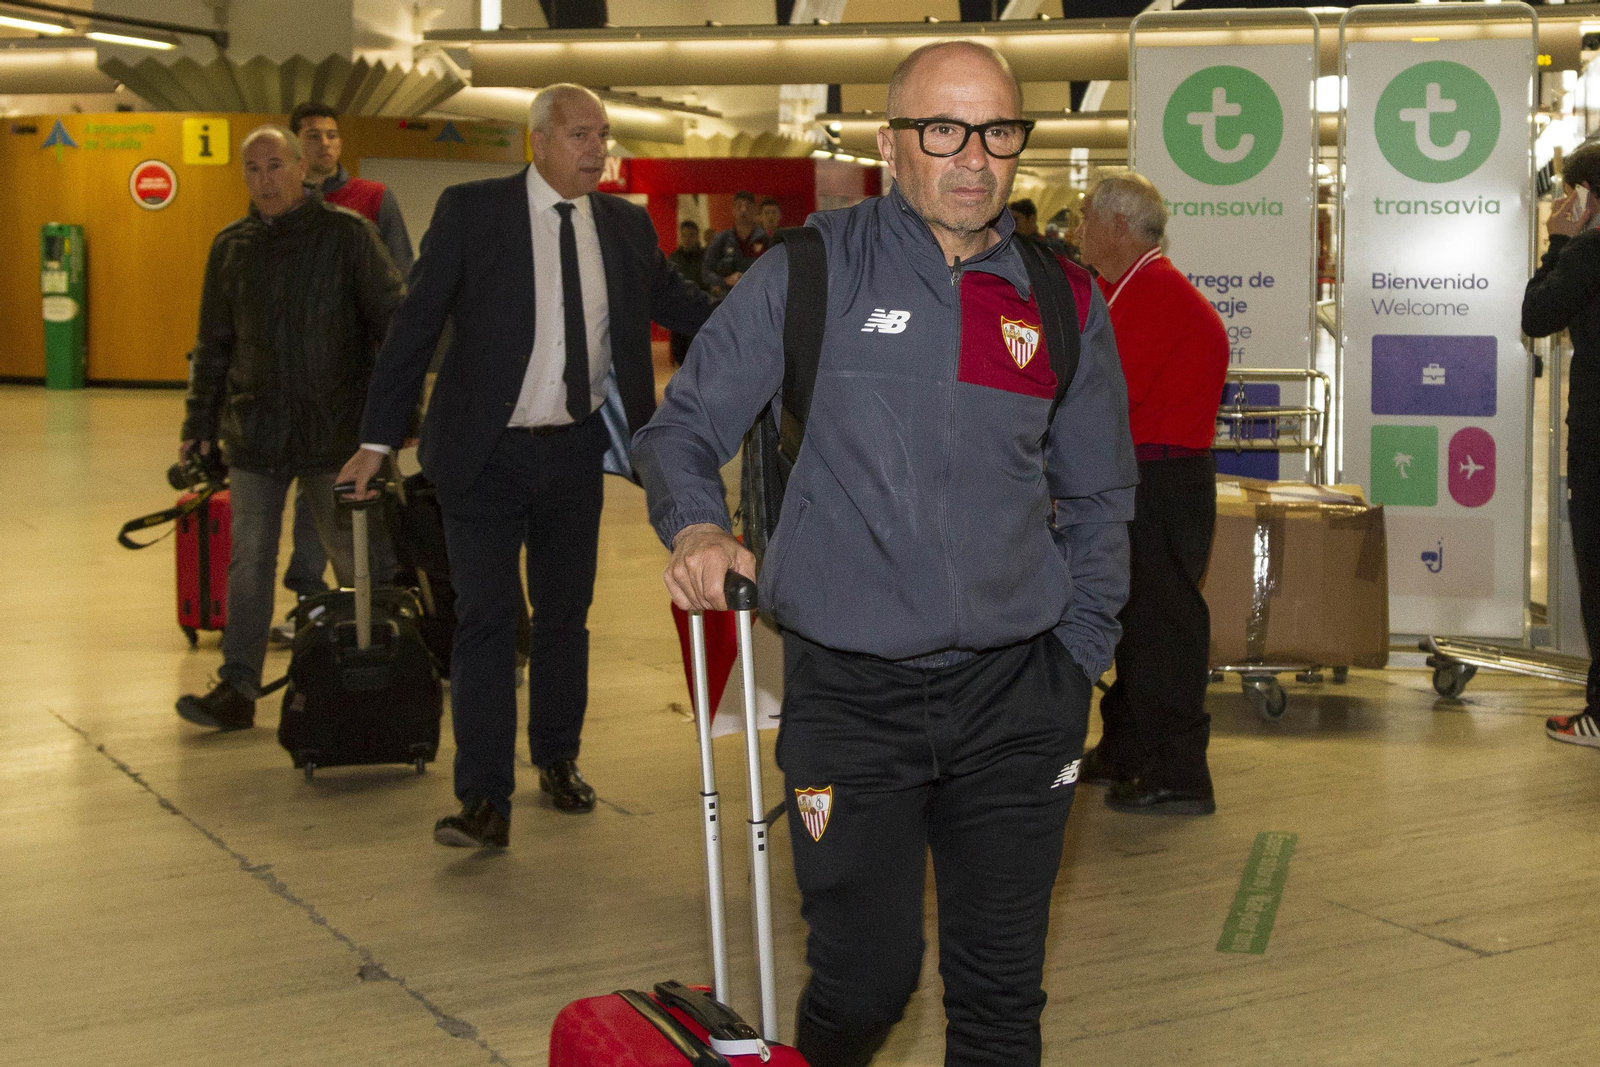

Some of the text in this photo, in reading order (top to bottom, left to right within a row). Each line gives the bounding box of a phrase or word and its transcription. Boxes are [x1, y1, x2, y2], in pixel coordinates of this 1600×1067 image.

[1373, 195, 1500, 215] transavia
[1187, 271, 1275, 294] trega de
[1371, 272, 1489, 290] Bienvenido
[1371, 298, 1469, 316] Welcome
